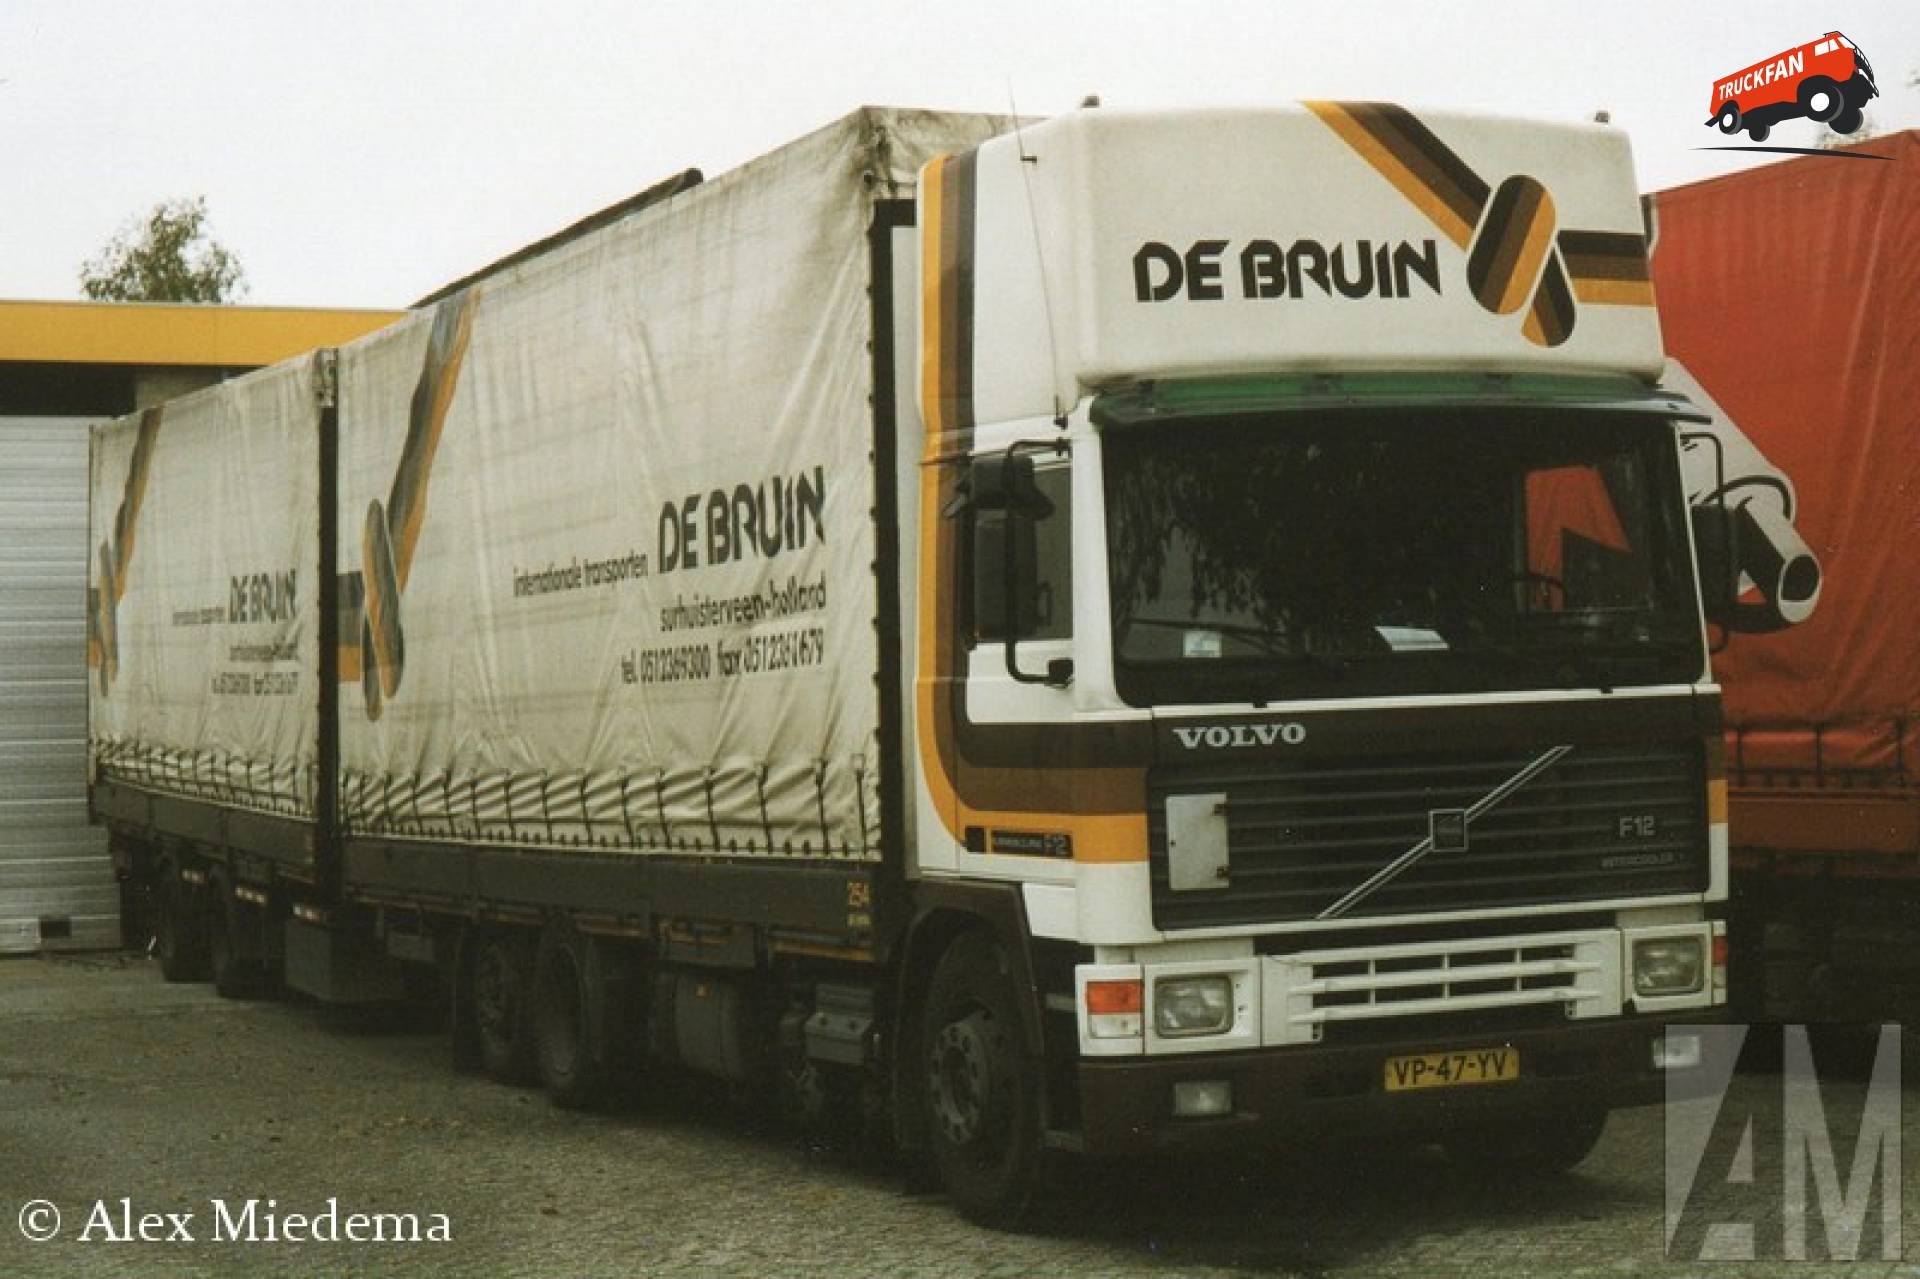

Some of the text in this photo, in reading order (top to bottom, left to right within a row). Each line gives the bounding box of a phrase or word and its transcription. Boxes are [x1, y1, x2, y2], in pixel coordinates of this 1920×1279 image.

[1133, 240, 1442, 302] DE BRUIN
[658, 493, 702, 574] DE
[707, 465, 826, 565] BRUIN
[1172, 722, 1307, 750] VOLVO
[1619, 815, 1656, 838] F12
[1393, 1050, 1508, 1087] VP-47-YV
